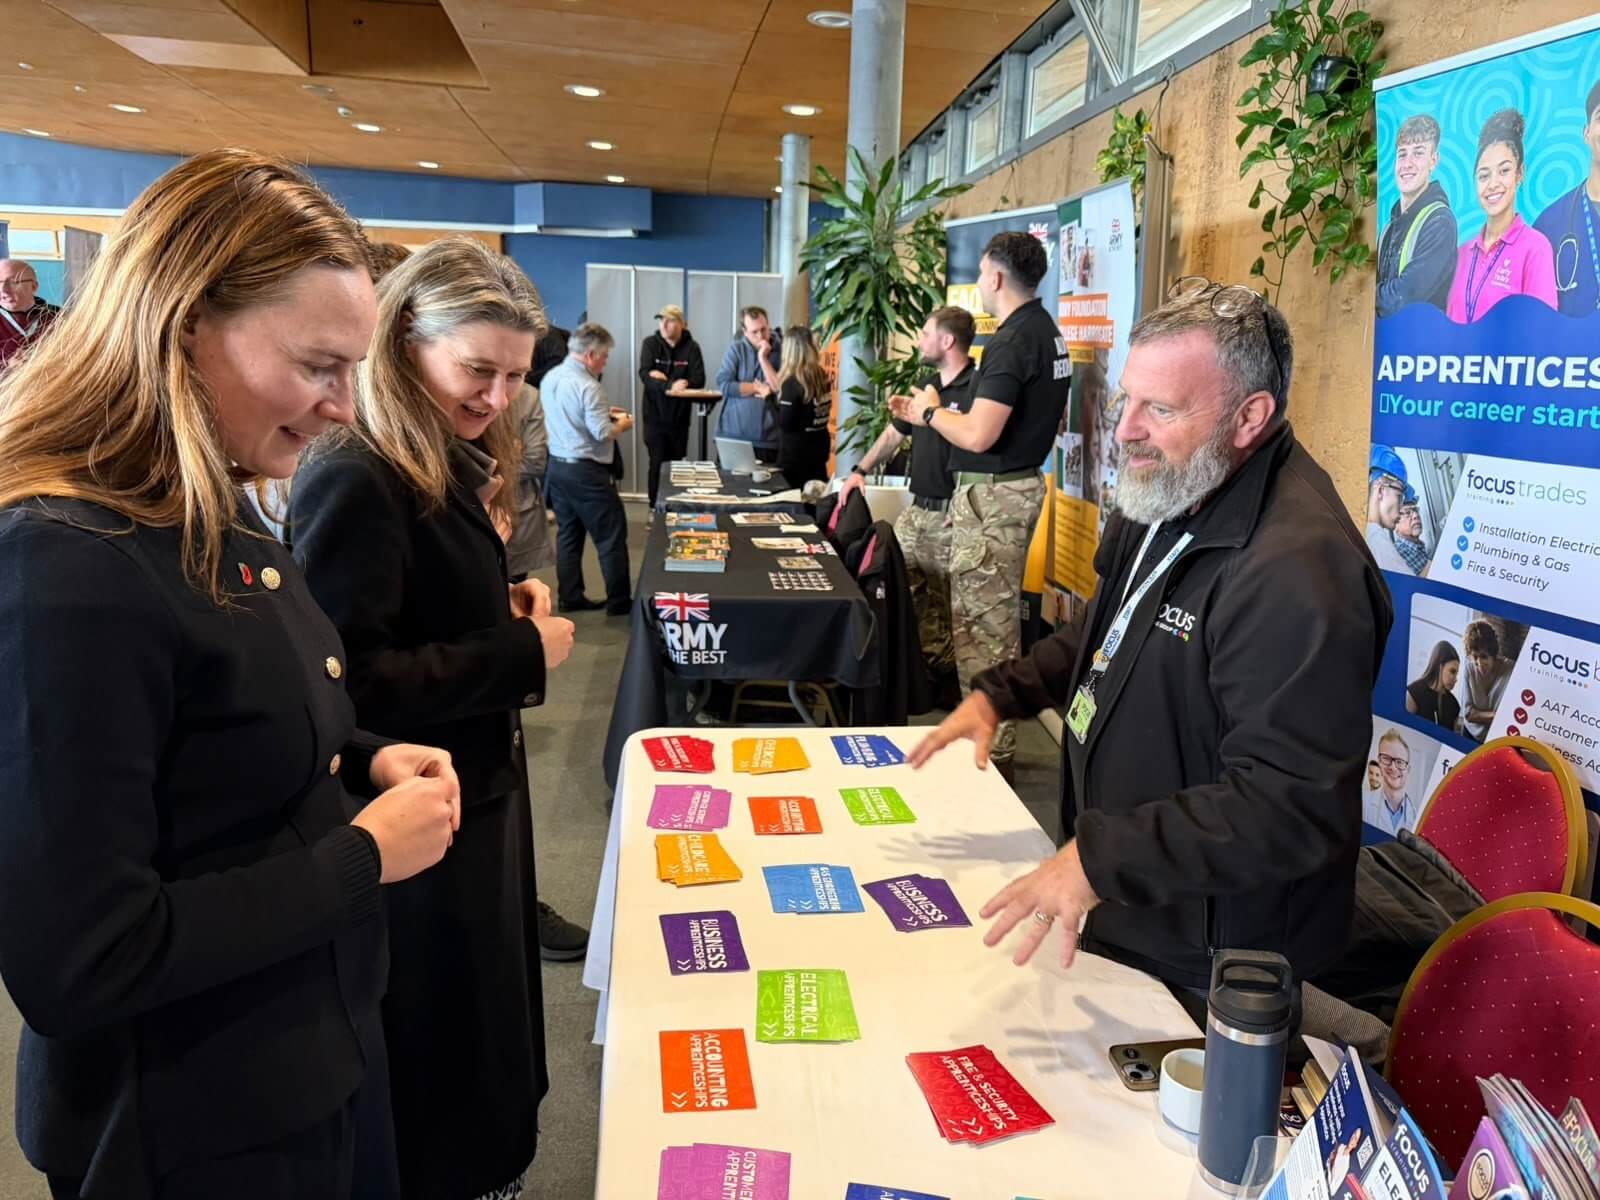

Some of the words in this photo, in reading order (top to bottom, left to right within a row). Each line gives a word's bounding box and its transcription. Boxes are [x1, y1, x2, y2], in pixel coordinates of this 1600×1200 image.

[1450, 400, 1527, 424] career
[1479, 522, 1546, 547] Installation
[1466, 560, 1487, 576] Fire
[1488, 565, 1496, 577] &
[1498, 569, 1550, 593] Security
[1473, 541, 1529, 567] Plumbing
[1532, 555, 1541, 567] &
[1544, 557, 1571, 573] Gas
[692, 650, 728, 665] BEST
[1530, 643, 1591, 679] focus
[1541, 698, 1570, 717] AAT
[1534, 717, 1600, 750] Customer
[886, 882, 934, 925] APPRENTICESHIPS
[895, 879, 949, 923] BUSINESS
[689, 919, 707, 971] APPRENTICESHIPS
[703, 918, 728, 969] BUSINESS
[783, 972, 796, 1037] APPRENTICESHIPS
[800, 972, 818, 1036] ELECTRICAL
[690, 1033, 708, 1109] APPRENTICESHIPS
[704, 1032, 729, 1108] ACCOUNTING
[957, 1056, 975, 1073] FIRE
[974, 1072, 983, 1082] &
[979, 1081, 1020, 1123] SECURITY
[940, 1055, 1006, 1131] APPRENTICESHIPS
[1394, 1124, 1431, 1193] focus
